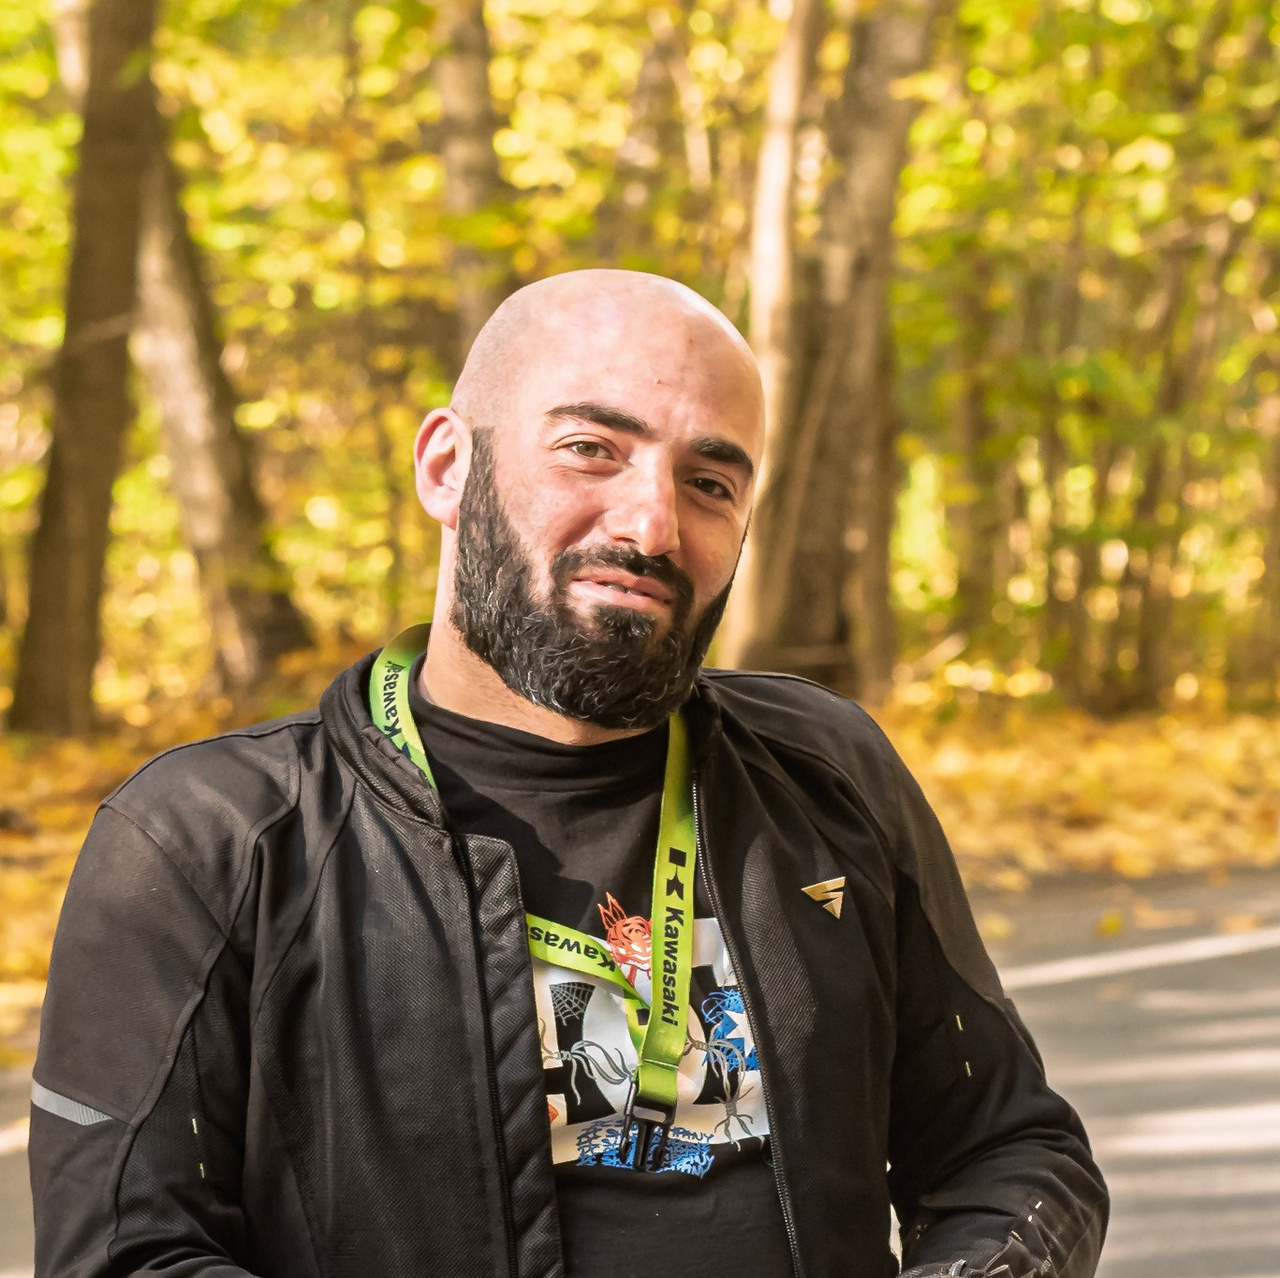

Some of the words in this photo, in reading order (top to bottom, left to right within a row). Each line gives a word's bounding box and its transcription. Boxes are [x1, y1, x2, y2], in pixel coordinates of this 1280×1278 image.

[383, 660, 407, 739] Kawas
[529, 926, 616, 973] Kawas
[662, 907, 685, 1026] Kawasaki
